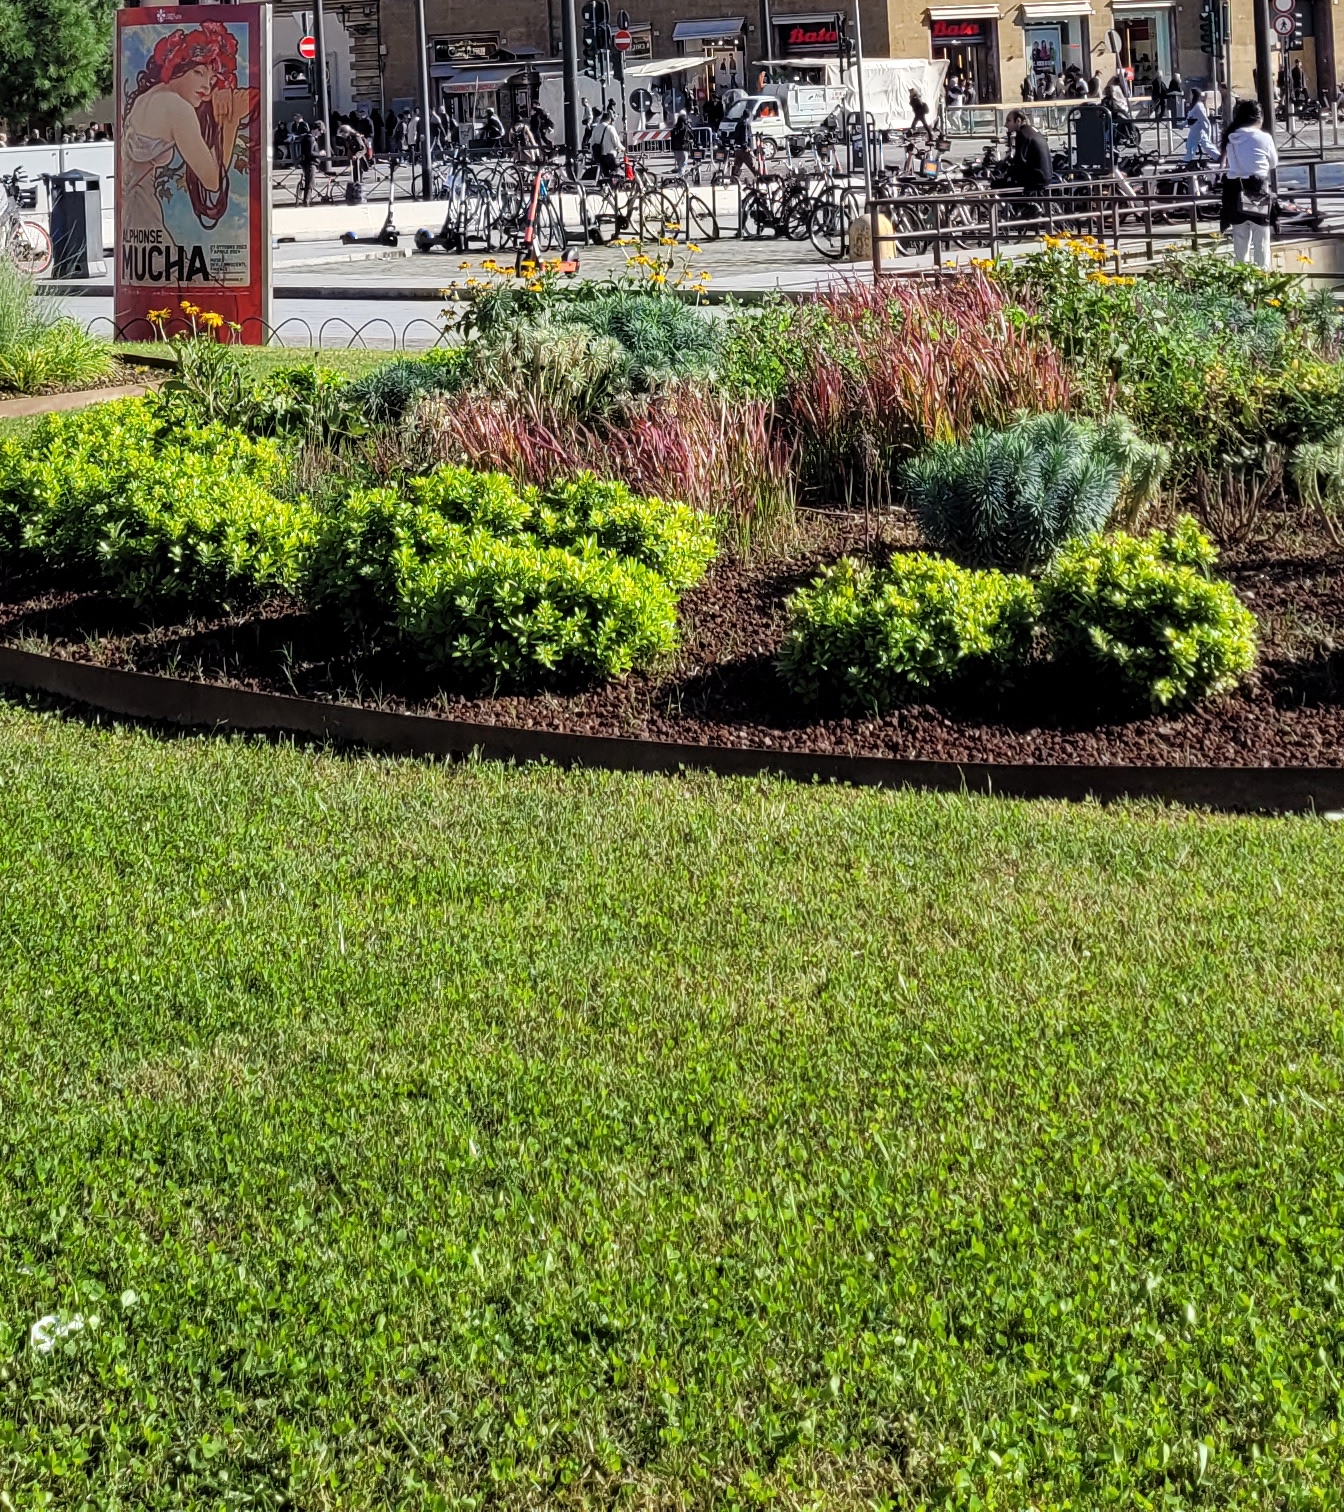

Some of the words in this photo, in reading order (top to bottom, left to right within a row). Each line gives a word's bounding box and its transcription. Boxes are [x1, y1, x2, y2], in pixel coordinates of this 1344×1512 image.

[788, 28, 837, 43] Bata
[933, 21, 979, 36] Bata
[123, 229, 163, 244] ALPHONSE
[122, 245, 211, 282] MUCHA
